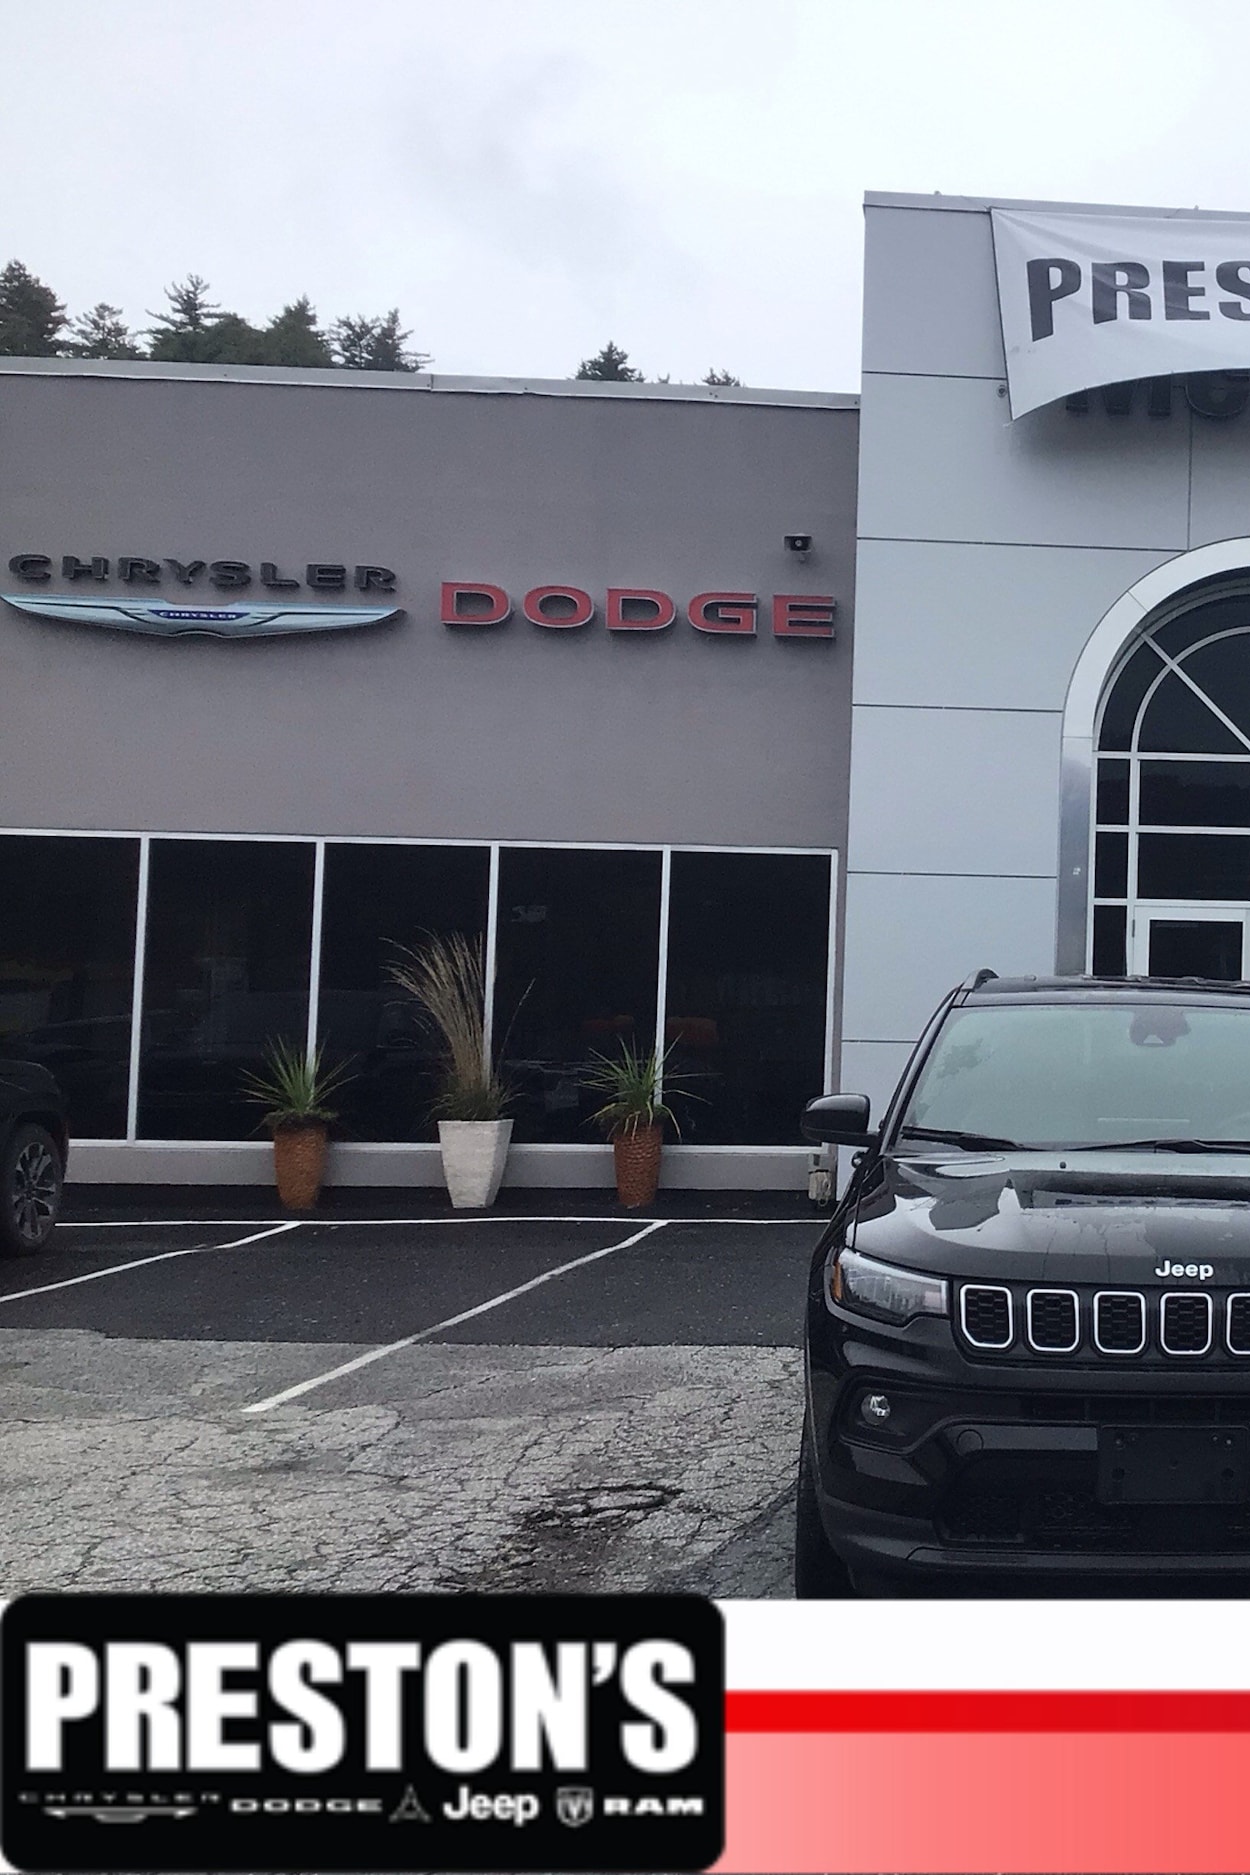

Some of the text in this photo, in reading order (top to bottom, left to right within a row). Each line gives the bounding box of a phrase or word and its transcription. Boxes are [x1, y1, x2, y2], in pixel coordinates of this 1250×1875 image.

[7, 553, 397, 593] CHRYSLER
[159, 611, 237, 620] CHRYSLER
[441, 581, 837, 639] DODGE
[1155, 1260, 1214, 1281] Jeep
